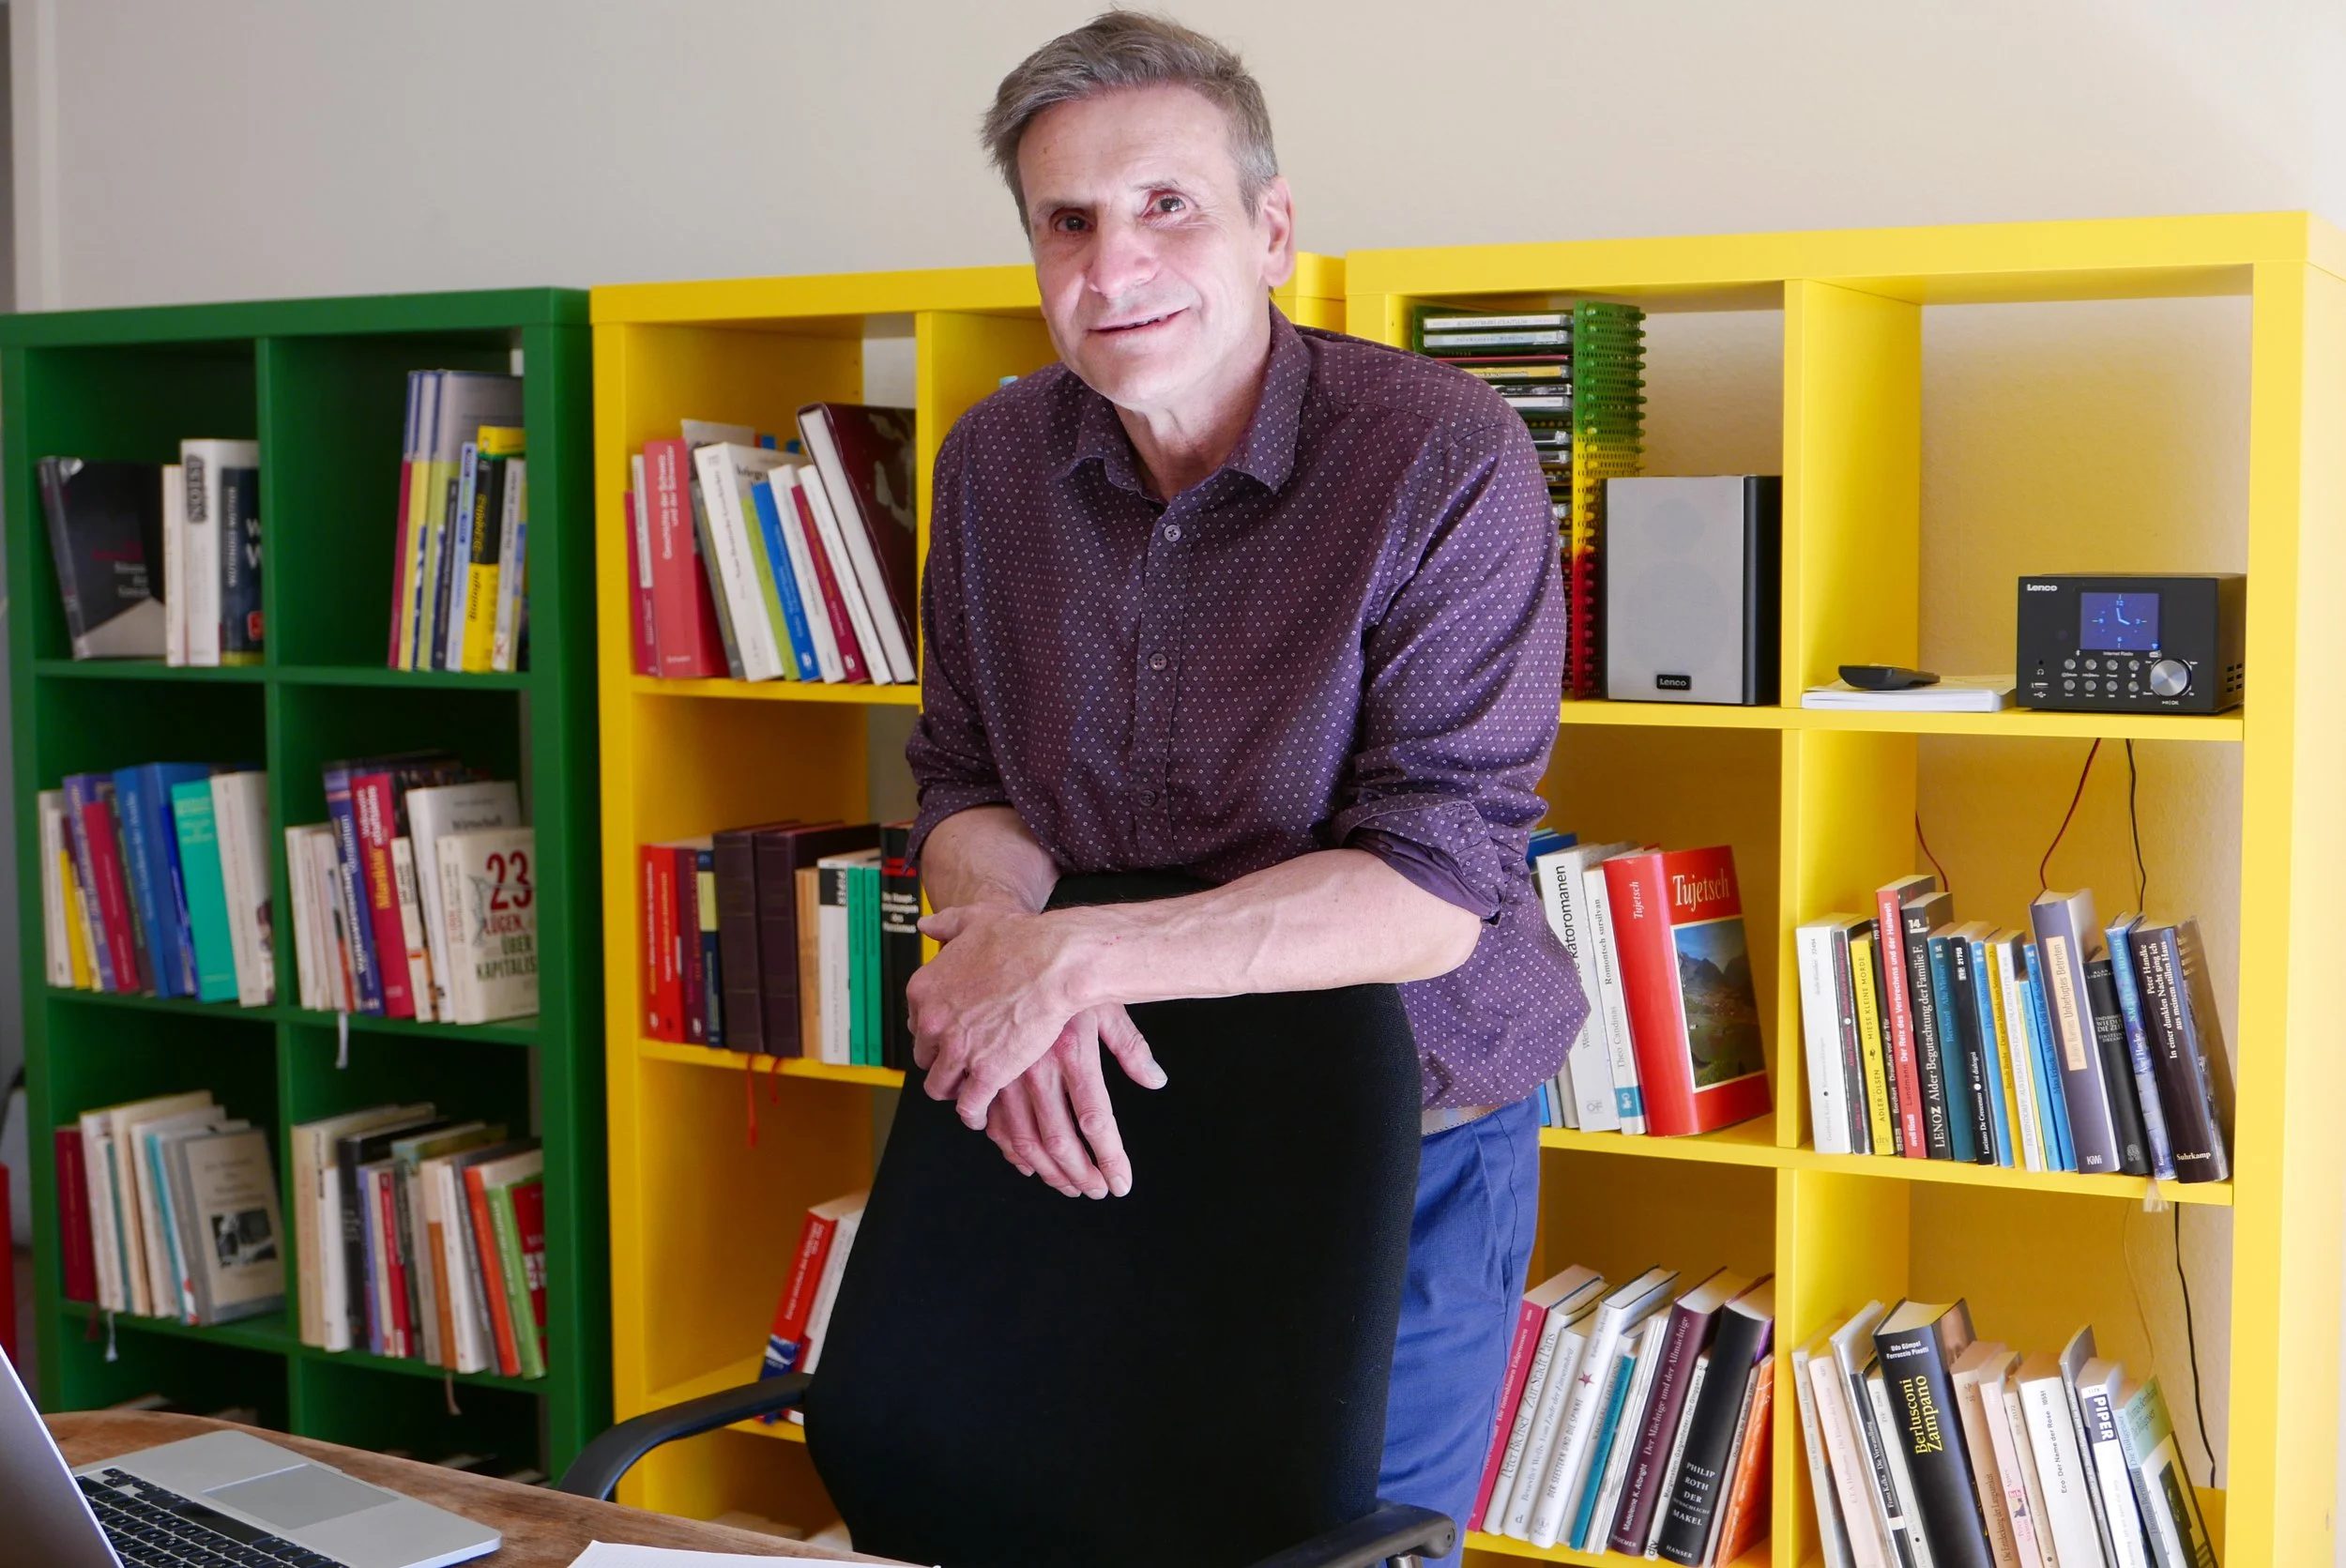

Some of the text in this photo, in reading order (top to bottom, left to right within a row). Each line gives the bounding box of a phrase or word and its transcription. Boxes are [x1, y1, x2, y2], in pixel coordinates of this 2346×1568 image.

[2027, 584, 2058, 592] Lenco
[1660, 677, 1687, 687] Lenco
[486, 850, 533, 911] 23
[1672, 868, 1730, 912] Tujetsch
[1629, 881, 1644, 920] Tujetsch
[1594, 899, 1613, 986] Romontsch sursilvan
[1912, 944, 1924, 953] F.
[2158, 940, 2170, 961] Haus
[1858, 956, 1867, 984] MORDE
[1912, 953, 1927, 987] Familie
[2051, 943, 2066, 975] Betreten
[2139, 944, 2155, 994] Peter Handke
[2162, 962, 2174, 984] stillen
[1882, 902, 1908, 1062] Der Reiz des Verbrechens und der Halbwelt
[1917, 988, 1929, 1004] der
[1862, 986, 1871, 1014] KLEINE
[2056, 976, 2074, 1018] Unbefugtes
[2148, 942, 2177, 1058] In einer dunklen Nacht ging ich
[2167, 986, 2180, 1015] meinem
[1881, 1017, 1890, 1028] Tür
[1883, 1029, 1892, 1043] der
[1942, 1011, 1954, 1042] Bernhard
[1610, 1006, 1626, 1071] Theo Candinas
[1884, 1043, 1893, 1054] vor
[2131, 1032, 2143, 1056] Hacke
[1903, 1064, 1912, 1105] Landmann
[1889, 1087, 1899, 1113] Borchert
[1975, 1092, 1986, 1120] Crescenzo
[1930, 1105, 1945, 1148] LENOZ
[1979, 1121, 1988, 1130] De
[2176, 1150, 2212, 1161] Suhrkamp
[1886, 1351, 1912, 1360] Ferruccio
[1529, 1357, 1547, 1386] Stadt
[1643, 1316, 1689, 1455] Der Mächtige und der Allmächtige
[1899, 1377, 1930, 1455] Berlusconi
[1914, 1375, 1944, 1454] Zampano
[2094, 1395, 2114, 1440] PIPER
[1508, 1414, 1530, 1452] Bichsel
[1546, 1397, 1583, 1498] DER SEESTERN UND DIE SPINNE
[1500, 1449, 1518, 1478] Peter
[1686, 1462, 1715, 1478] PHILIP
[1866, 1420, 1894, 1508] Franz Kafka Die Verwandlung
[1521, 1467, 1538, 1501] Benedict
[1622, 1463, 1649, 1531] Madeleine K. Albright
[1683, 1491, 1702, 1503] DER
[1684, 1477, 1709, 1491] ROTH
[2059, 1480, 2067, 1493] Eco
[2132, 1469, 2150, 1504] Bernhard
[1673, 1510, 1702, 1526] MAKEL
[1990, 1507, 2003, 1518] der
[2141, 1505, 2158, 1536] Thomas
[1993, 1517, 2009, 1551] Entdeckung
[1666, 1545, 1693, 1558] HANSER
[2002, 1549, 2013, 1561] Die
